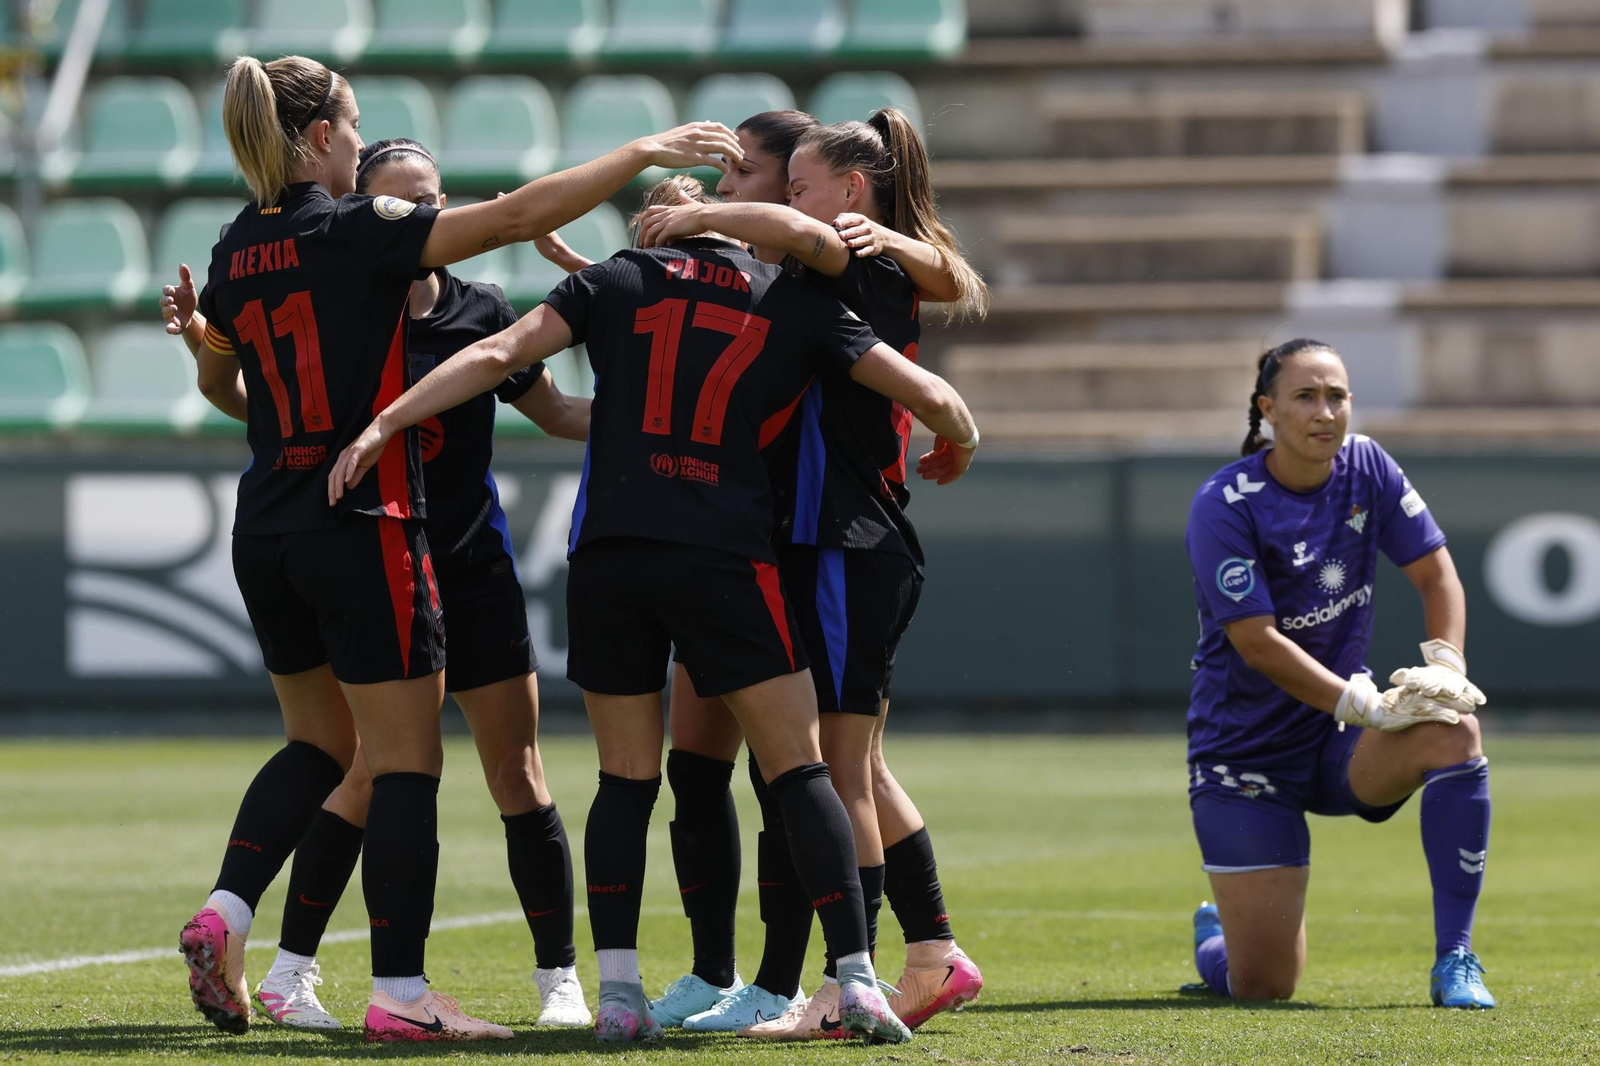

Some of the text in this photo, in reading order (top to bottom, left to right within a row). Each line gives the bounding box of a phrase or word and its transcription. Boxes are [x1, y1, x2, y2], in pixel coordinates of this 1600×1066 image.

[229, 238, 300, 281] ALEXIA
[666, 258, 752, 293] PAJOR
[232, 290, 335, 439] 11
[633, 297, 773, 446] 17
[679, 456, 720, 474] UNHCR
[679, 466, 719, 483] ACNUR
